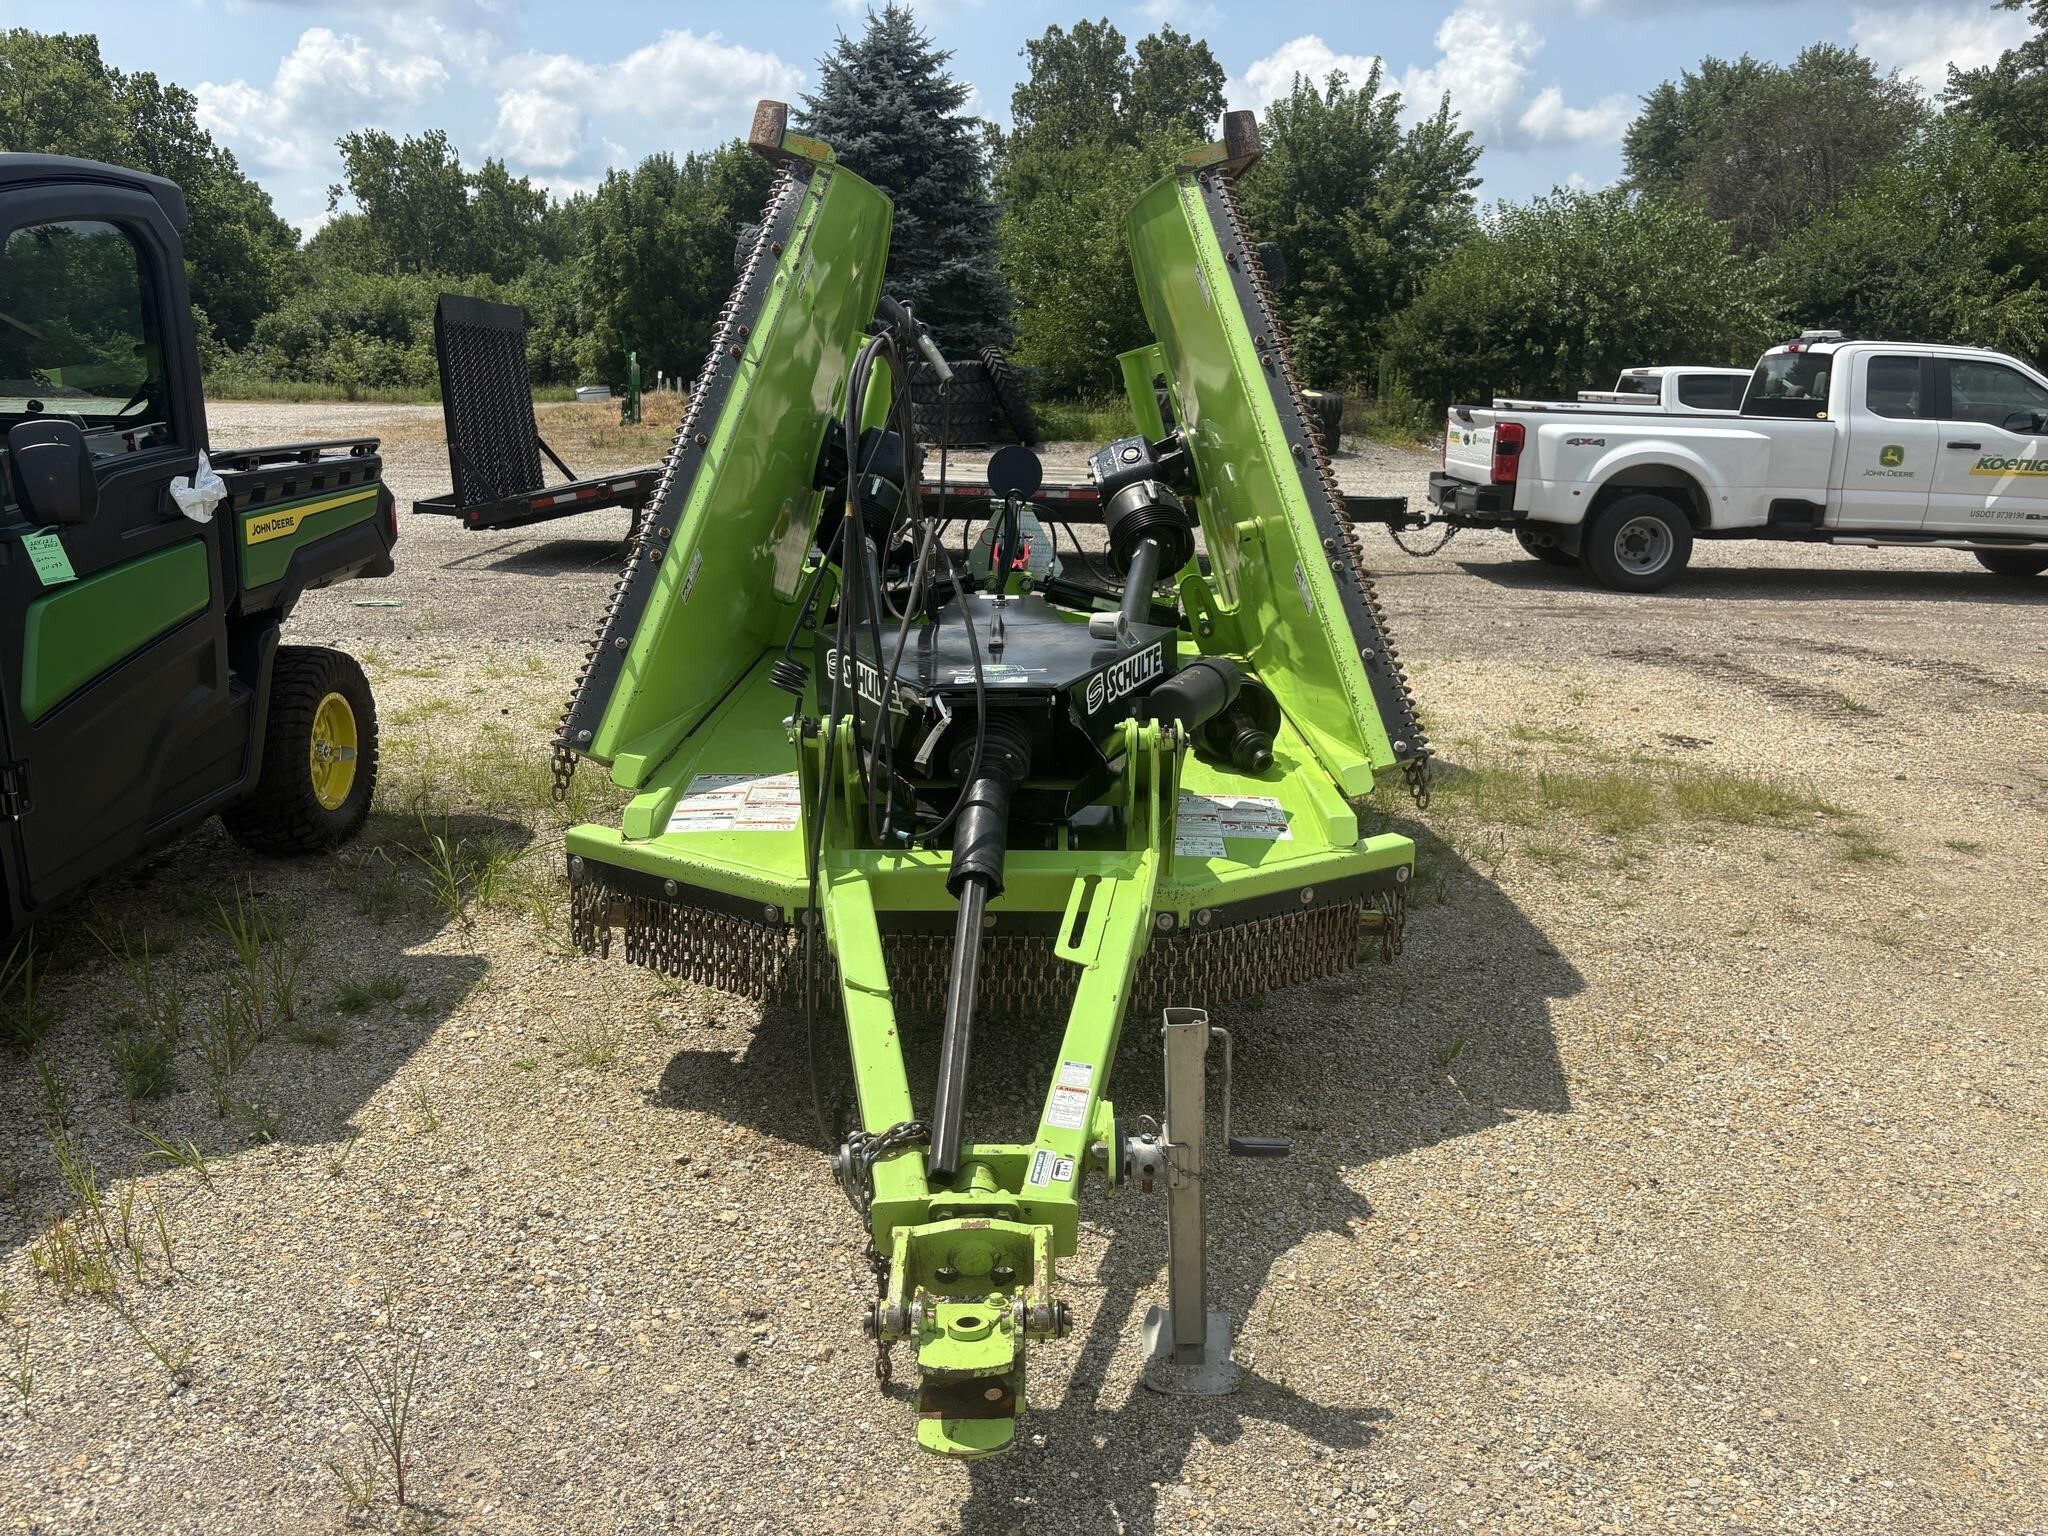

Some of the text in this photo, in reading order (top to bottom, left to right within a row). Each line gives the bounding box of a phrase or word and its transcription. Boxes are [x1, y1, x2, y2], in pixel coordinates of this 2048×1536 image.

[1862, 469, 1914, 478] JOHN DEERE
[1970, 510, 1996, 518] USDOT
[251, 516, 295, 536] JOHN DEERE
[1106, 641, 1163, 704] SCHULTE
